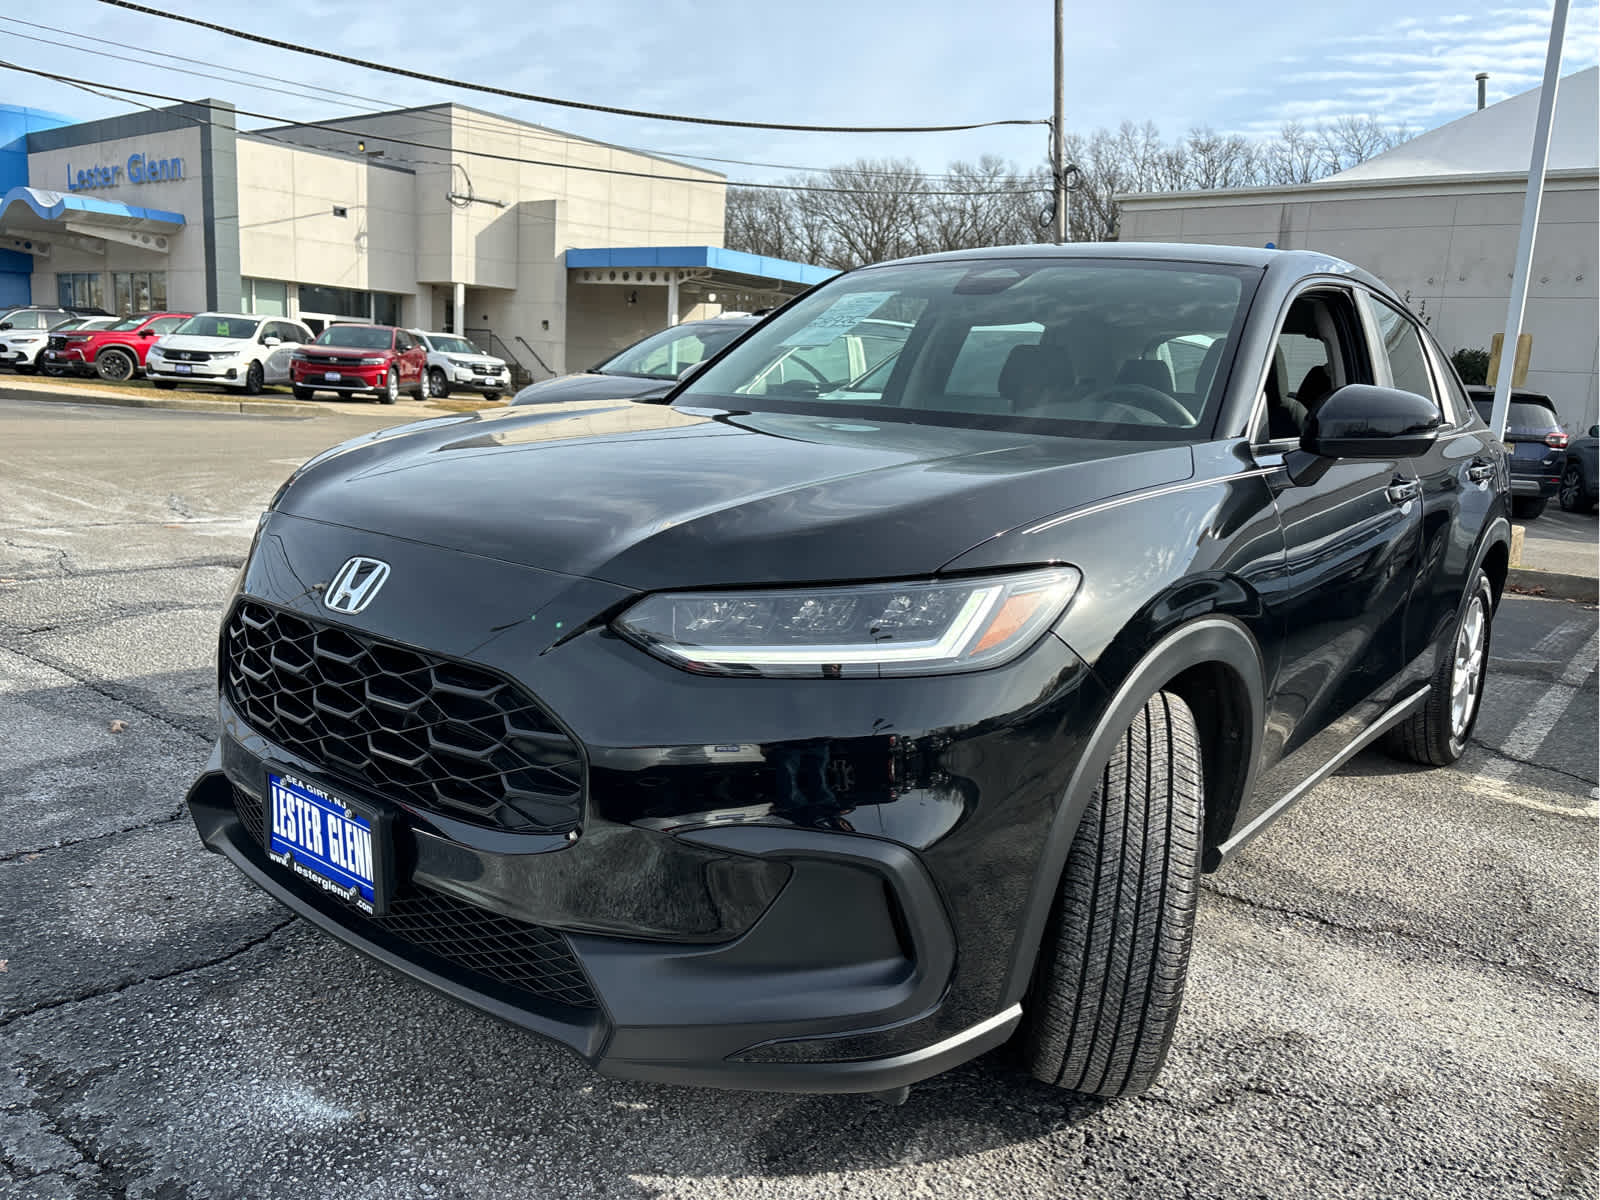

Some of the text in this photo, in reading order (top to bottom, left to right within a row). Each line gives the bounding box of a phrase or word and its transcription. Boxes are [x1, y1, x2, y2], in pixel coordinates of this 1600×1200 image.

[66, 152, 182, 190] Lester Glenn
[285, 775, 304, 789] SEA
[333, 796, 347, 809] NJ
[272, 785, 374, 883] LESTER GLENN
